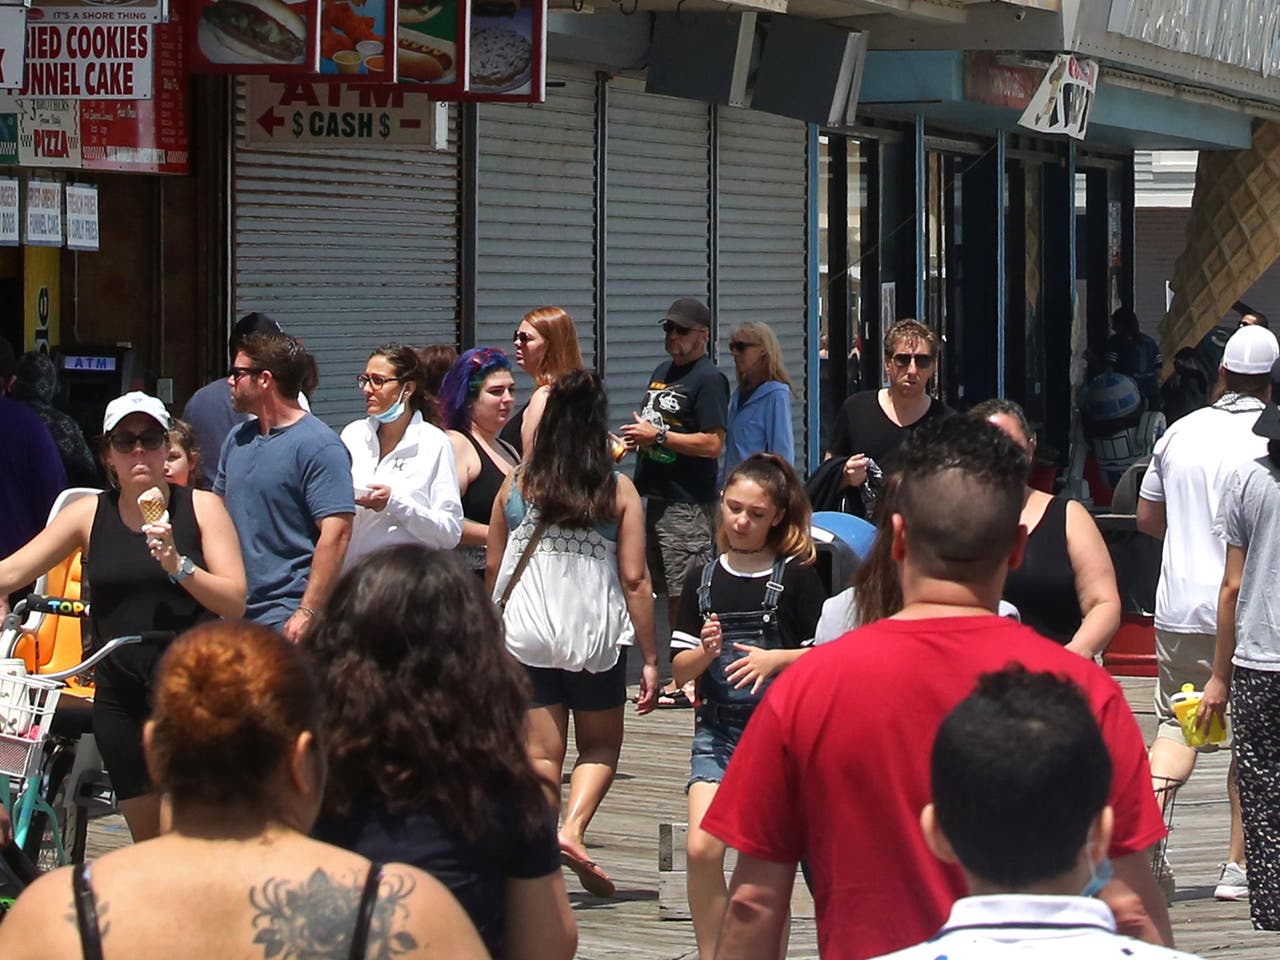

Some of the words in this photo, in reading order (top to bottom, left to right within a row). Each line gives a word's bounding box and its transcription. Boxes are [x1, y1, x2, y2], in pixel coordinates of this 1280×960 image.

[53, 12, 70, 20] IT'S
[73, 12, 80, 20] A
[83, 12, 114, 20] SHORE
[117, 12, 147, 20] THING
[67, 25, 147, 59] COOKIES
[84, 62, 133, 95] CAKE
[292, 110, 303, 139] $
[309, 111, 373, 138] CASH
[379, 112, 391, 140] $
[33, 129, 70, 158] PIZZA
[74, 357, 108, 370] ATM
